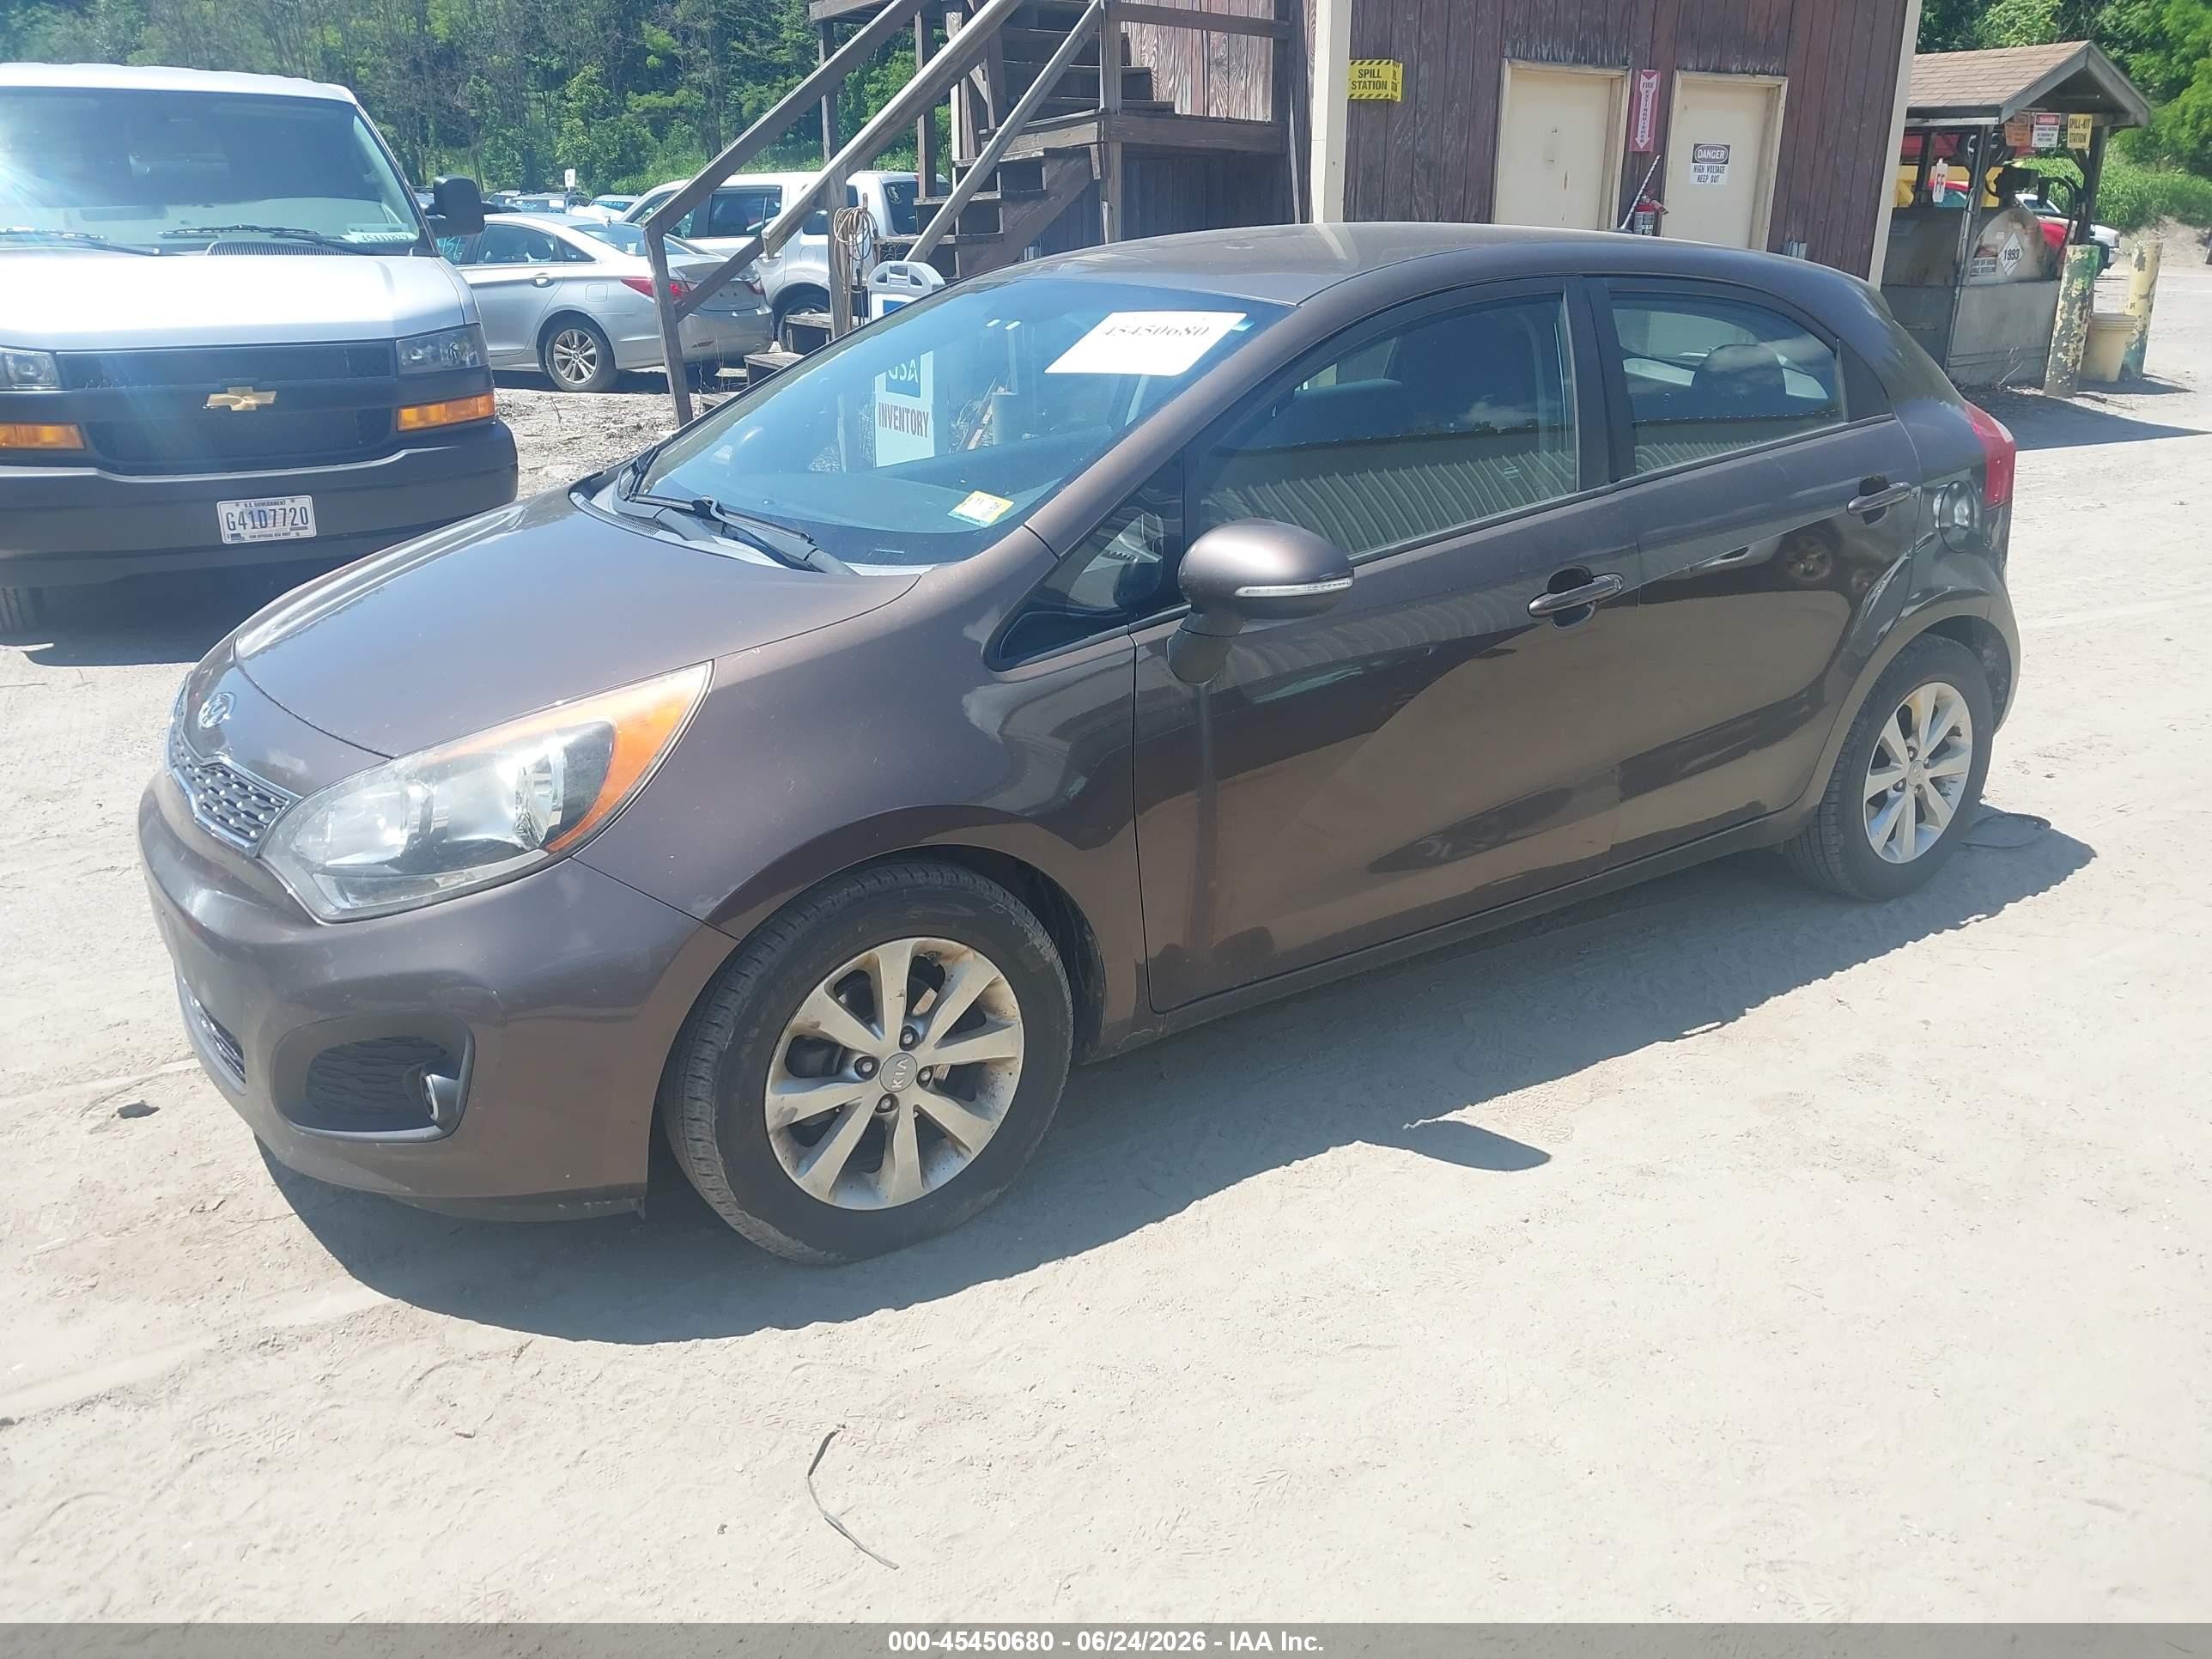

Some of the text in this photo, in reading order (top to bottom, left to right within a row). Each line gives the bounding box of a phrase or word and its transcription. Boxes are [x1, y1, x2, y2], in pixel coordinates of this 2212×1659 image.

[1358, 68, 1382, 79] SPILL
[1351, 80, 1388, 90] STATION
[1697, 149, 1725, 160] DANGER
[2003, 248, 2021, 261] 1993
[878, 402, 929, 439] INVENTORY
[226, 506, 310, 532] G41D7720
[891, 1057, 909, 1089] KIA
